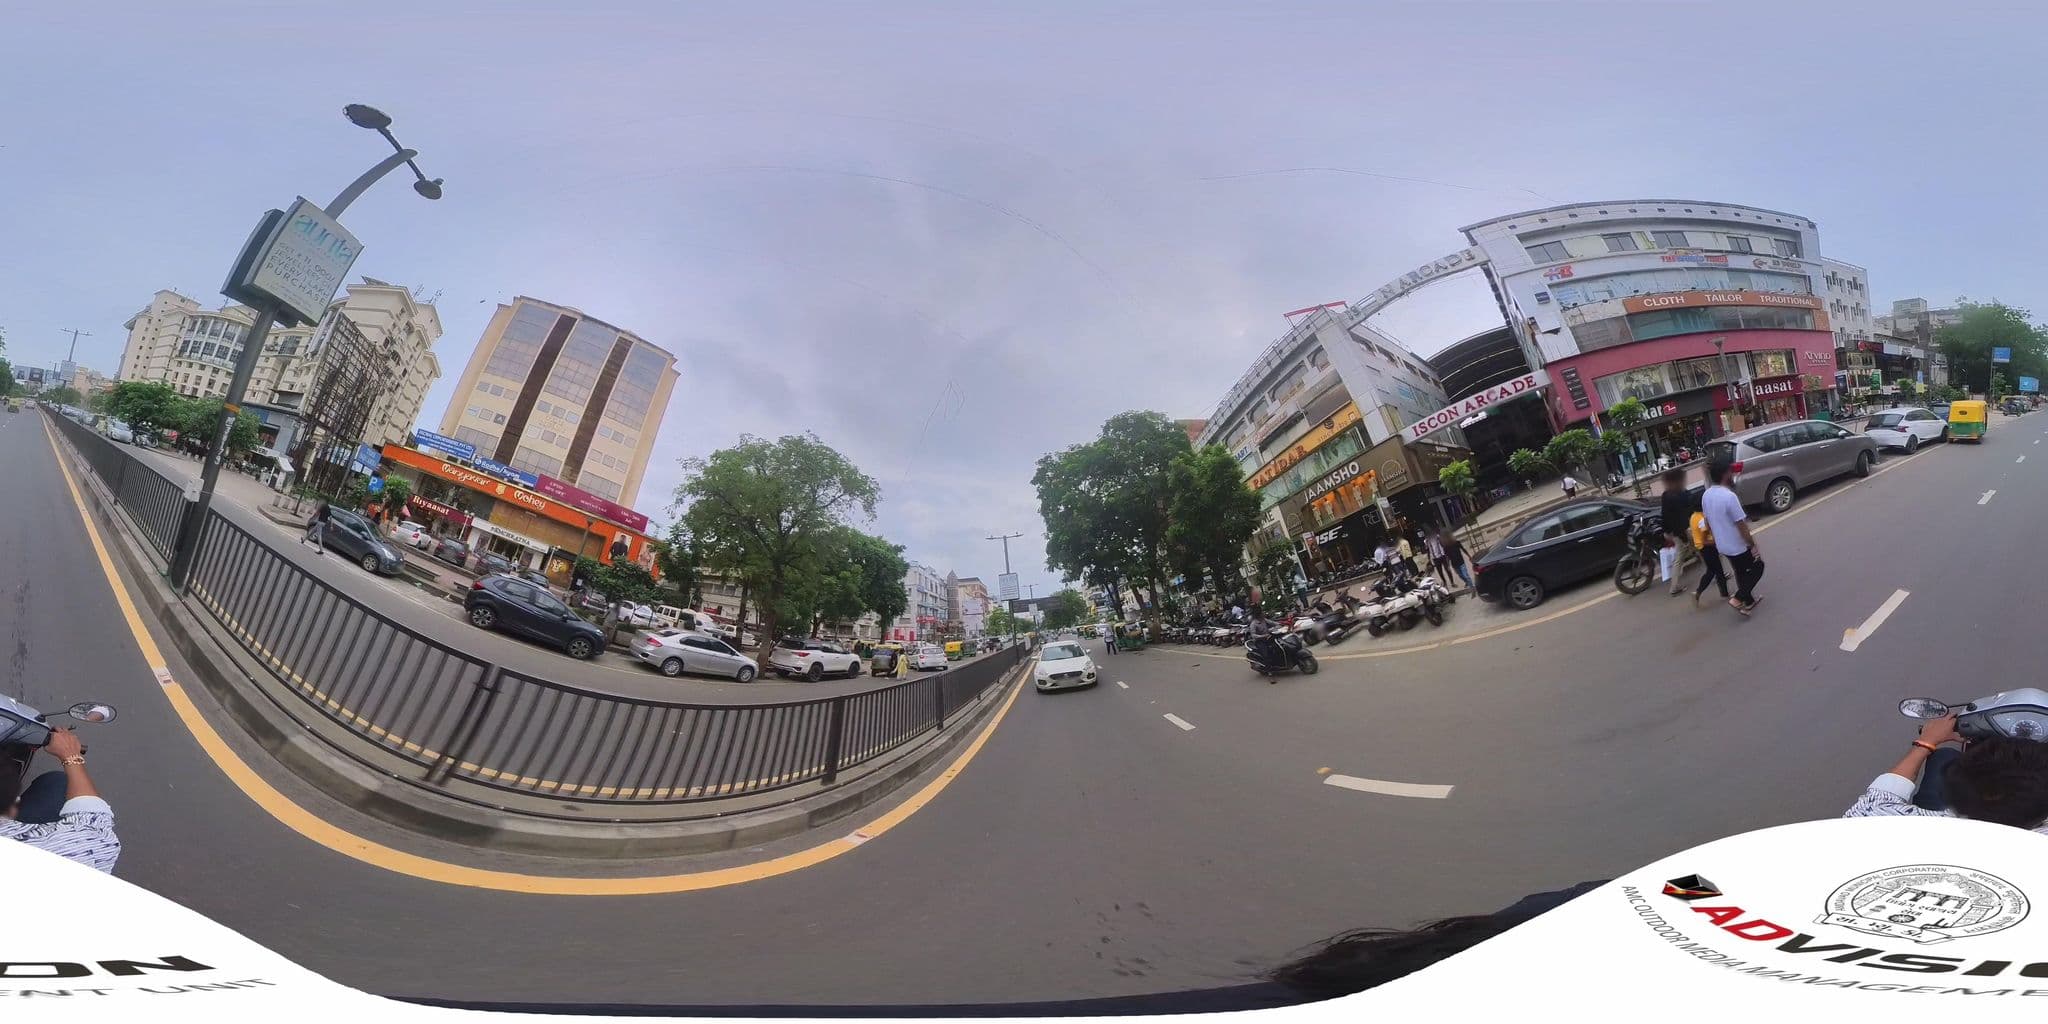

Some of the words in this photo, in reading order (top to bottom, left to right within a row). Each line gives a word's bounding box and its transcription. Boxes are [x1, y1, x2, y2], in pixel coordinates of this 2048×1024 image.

[265, 262, 326, 307] PURCHASE
[1399, 248, 1476, 290] ARCADE
[1644, 296, 1685, 308] CLOTH
[1705, 294, 1743, 303] TAILOR
[1759, 295, 1815, 306] TRADITIONAL
[1411, 404, 1460, 438] ISCON
[1465, 375, 1538, 418] ARCADE
[513, 490, 546, 511] Mohey
[1304, 461, 1360, 504] JAAMSHO
[412, 494, 450, 516] Riyaasat
